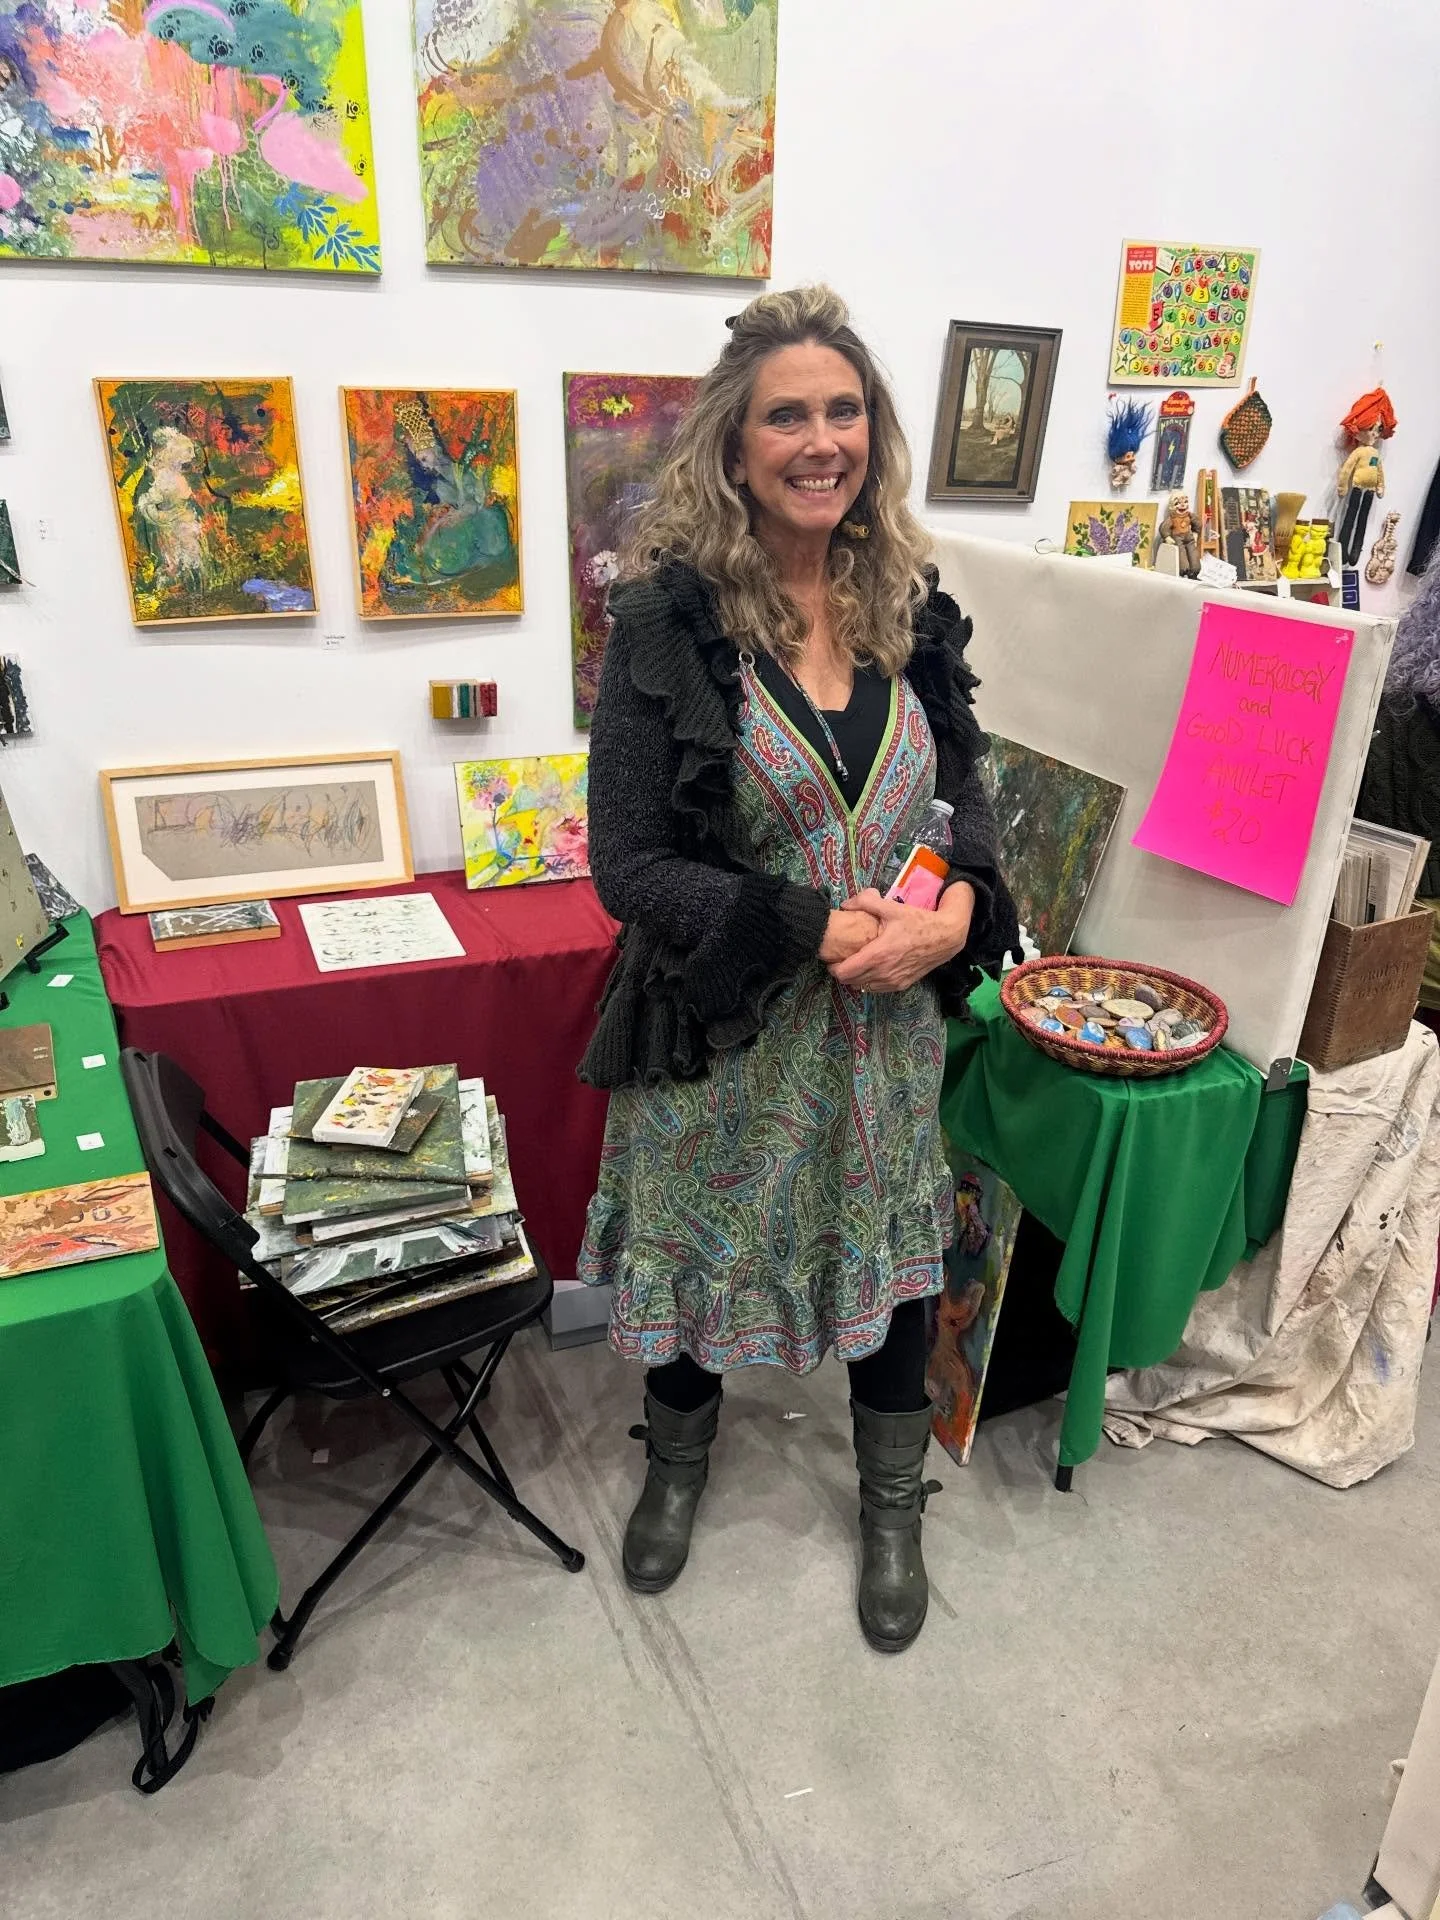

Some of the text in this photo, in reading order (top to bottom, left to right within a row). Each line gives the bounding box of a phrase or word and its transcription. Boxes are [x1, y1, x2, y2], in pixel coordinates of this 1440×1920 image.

[1128, 260, 1154, 271] TOTS
[1152, 307, 1160, 321] 5
[1208, 641, 1336, 704] NUMEROLOGY
[1238, 696, 1273, 719] and
[1256, 725, 1315, 766] LUCK
[1202, 753, 1297, 805] AMULET
[1204, 799, 1262, 844] $20
